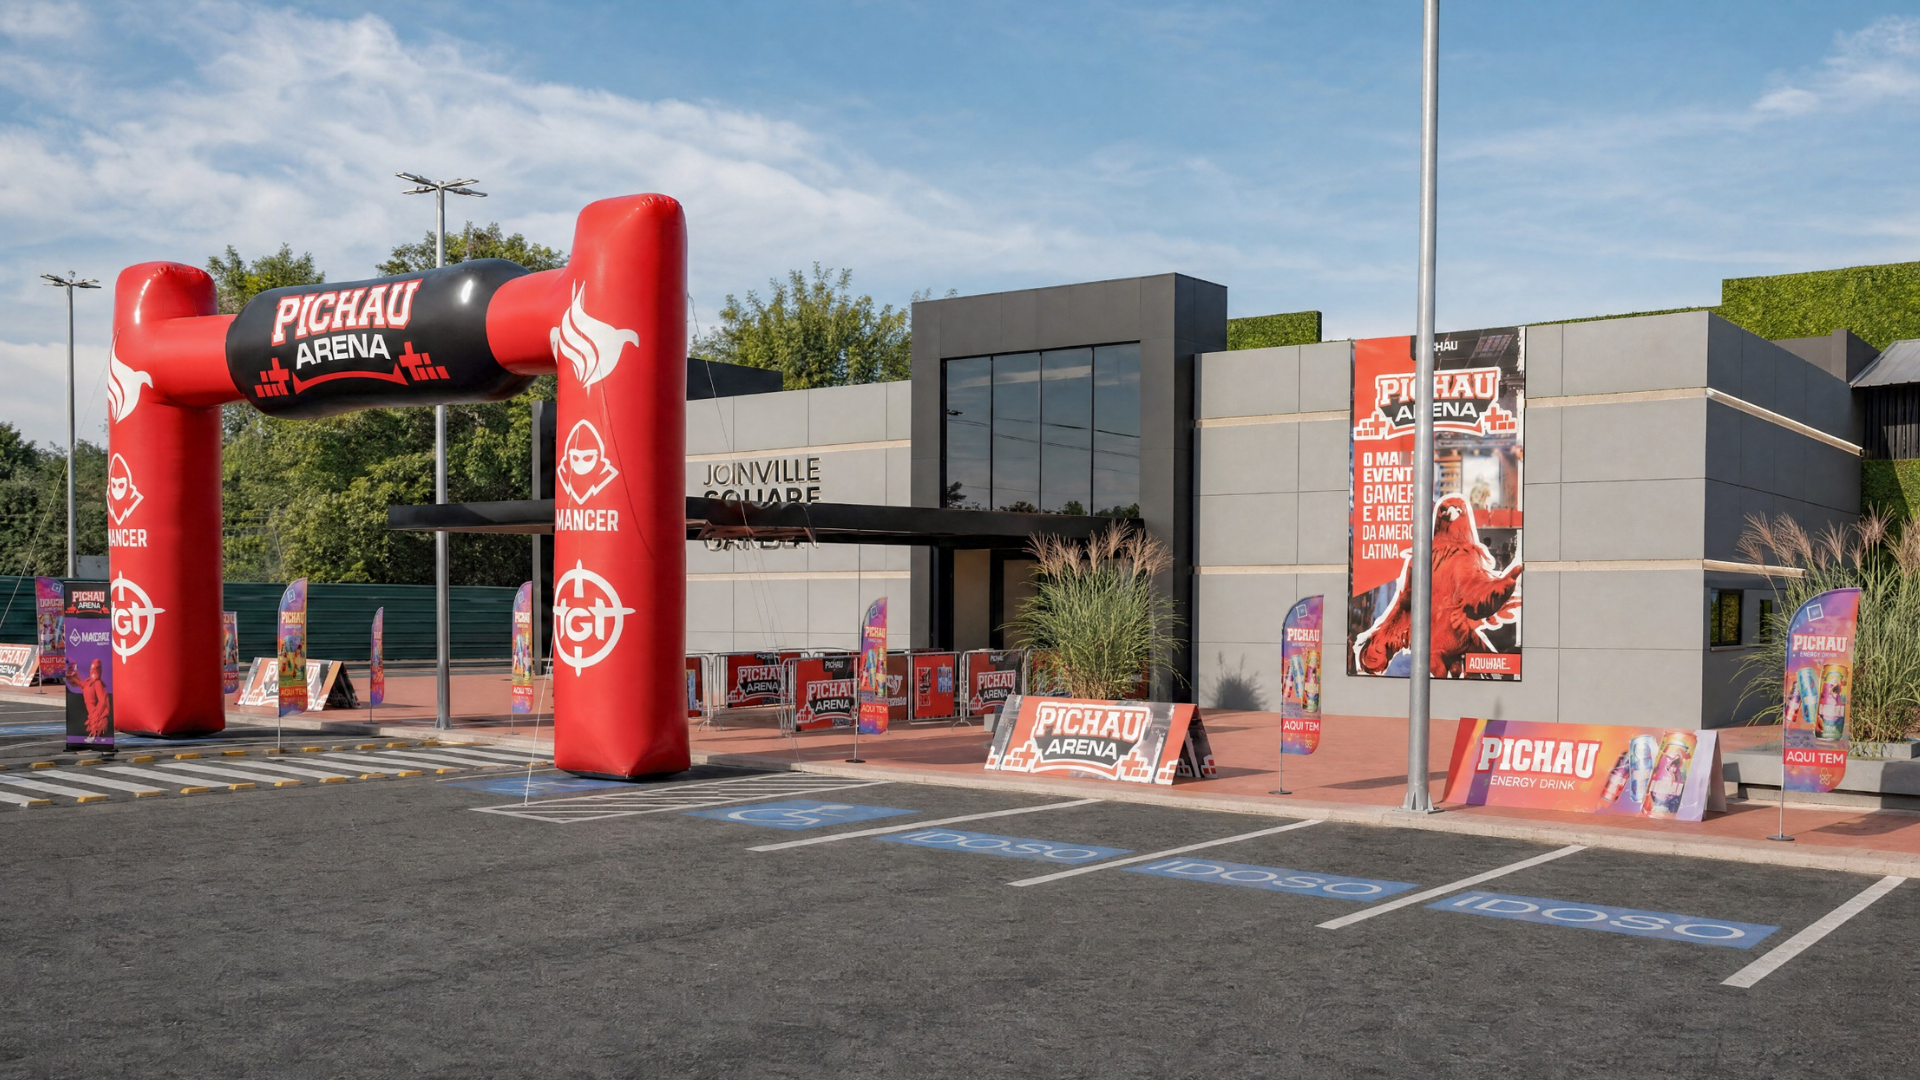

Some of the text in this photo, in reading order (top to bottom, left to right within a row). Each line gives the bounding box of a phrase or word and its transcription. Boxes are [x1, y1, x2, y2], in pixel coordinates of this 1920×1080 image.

[271, 278, 424, 346] PICHAU
[296, 333, 391, 370] ARENA
[1434, 341, 1458, 351] HAU
[1380, 372, 1497, 405] PIHAU
[1395, 402, 1478, 422] AENA
[1363, 452, 1373, 466] O
[704, 458, 820, 486] JOINVILLE
[1363, 467, 1413, 482] EVENT
[556, 509, 618, 531] MANCER
[1363, 505, 1372, 521] E
[1362, 525, 1376, 540] DA
[1362, 543, 1399, 559] LATINA
[72, 591, 105, 602] PICHAU
[1287, 628, 1320, 642] PICHAU
[1792, 634, 1847, 652] PICHAU
[0, 649, 30, 665] CHAU
[746, 681, 779, 692] ARENA
[978, 672, 1015, 688] PICHAU
[983, 689, 1008, 699] ARENA
[815, 699, 850, 711] ARENA
[861, 704, 887, 713] AQUI TEM
[1036, 706, 1143, 741] PICHAU
[1283, 720, 1319, 731] AQUI TEM
[1044, 739, 1118, 760] ARENA
[1786, 751, 1844, 764] AQUI TEM
[1477, 737, 1600, 779] PICHAU
[1490, 775, 1576, 791] ENERGY DRINK
[900, 830, 1099, 859] IDOSO
[1147, 860, 1383, 895] IDOSO
[1453, 896, 1746, 939] IDOSO
